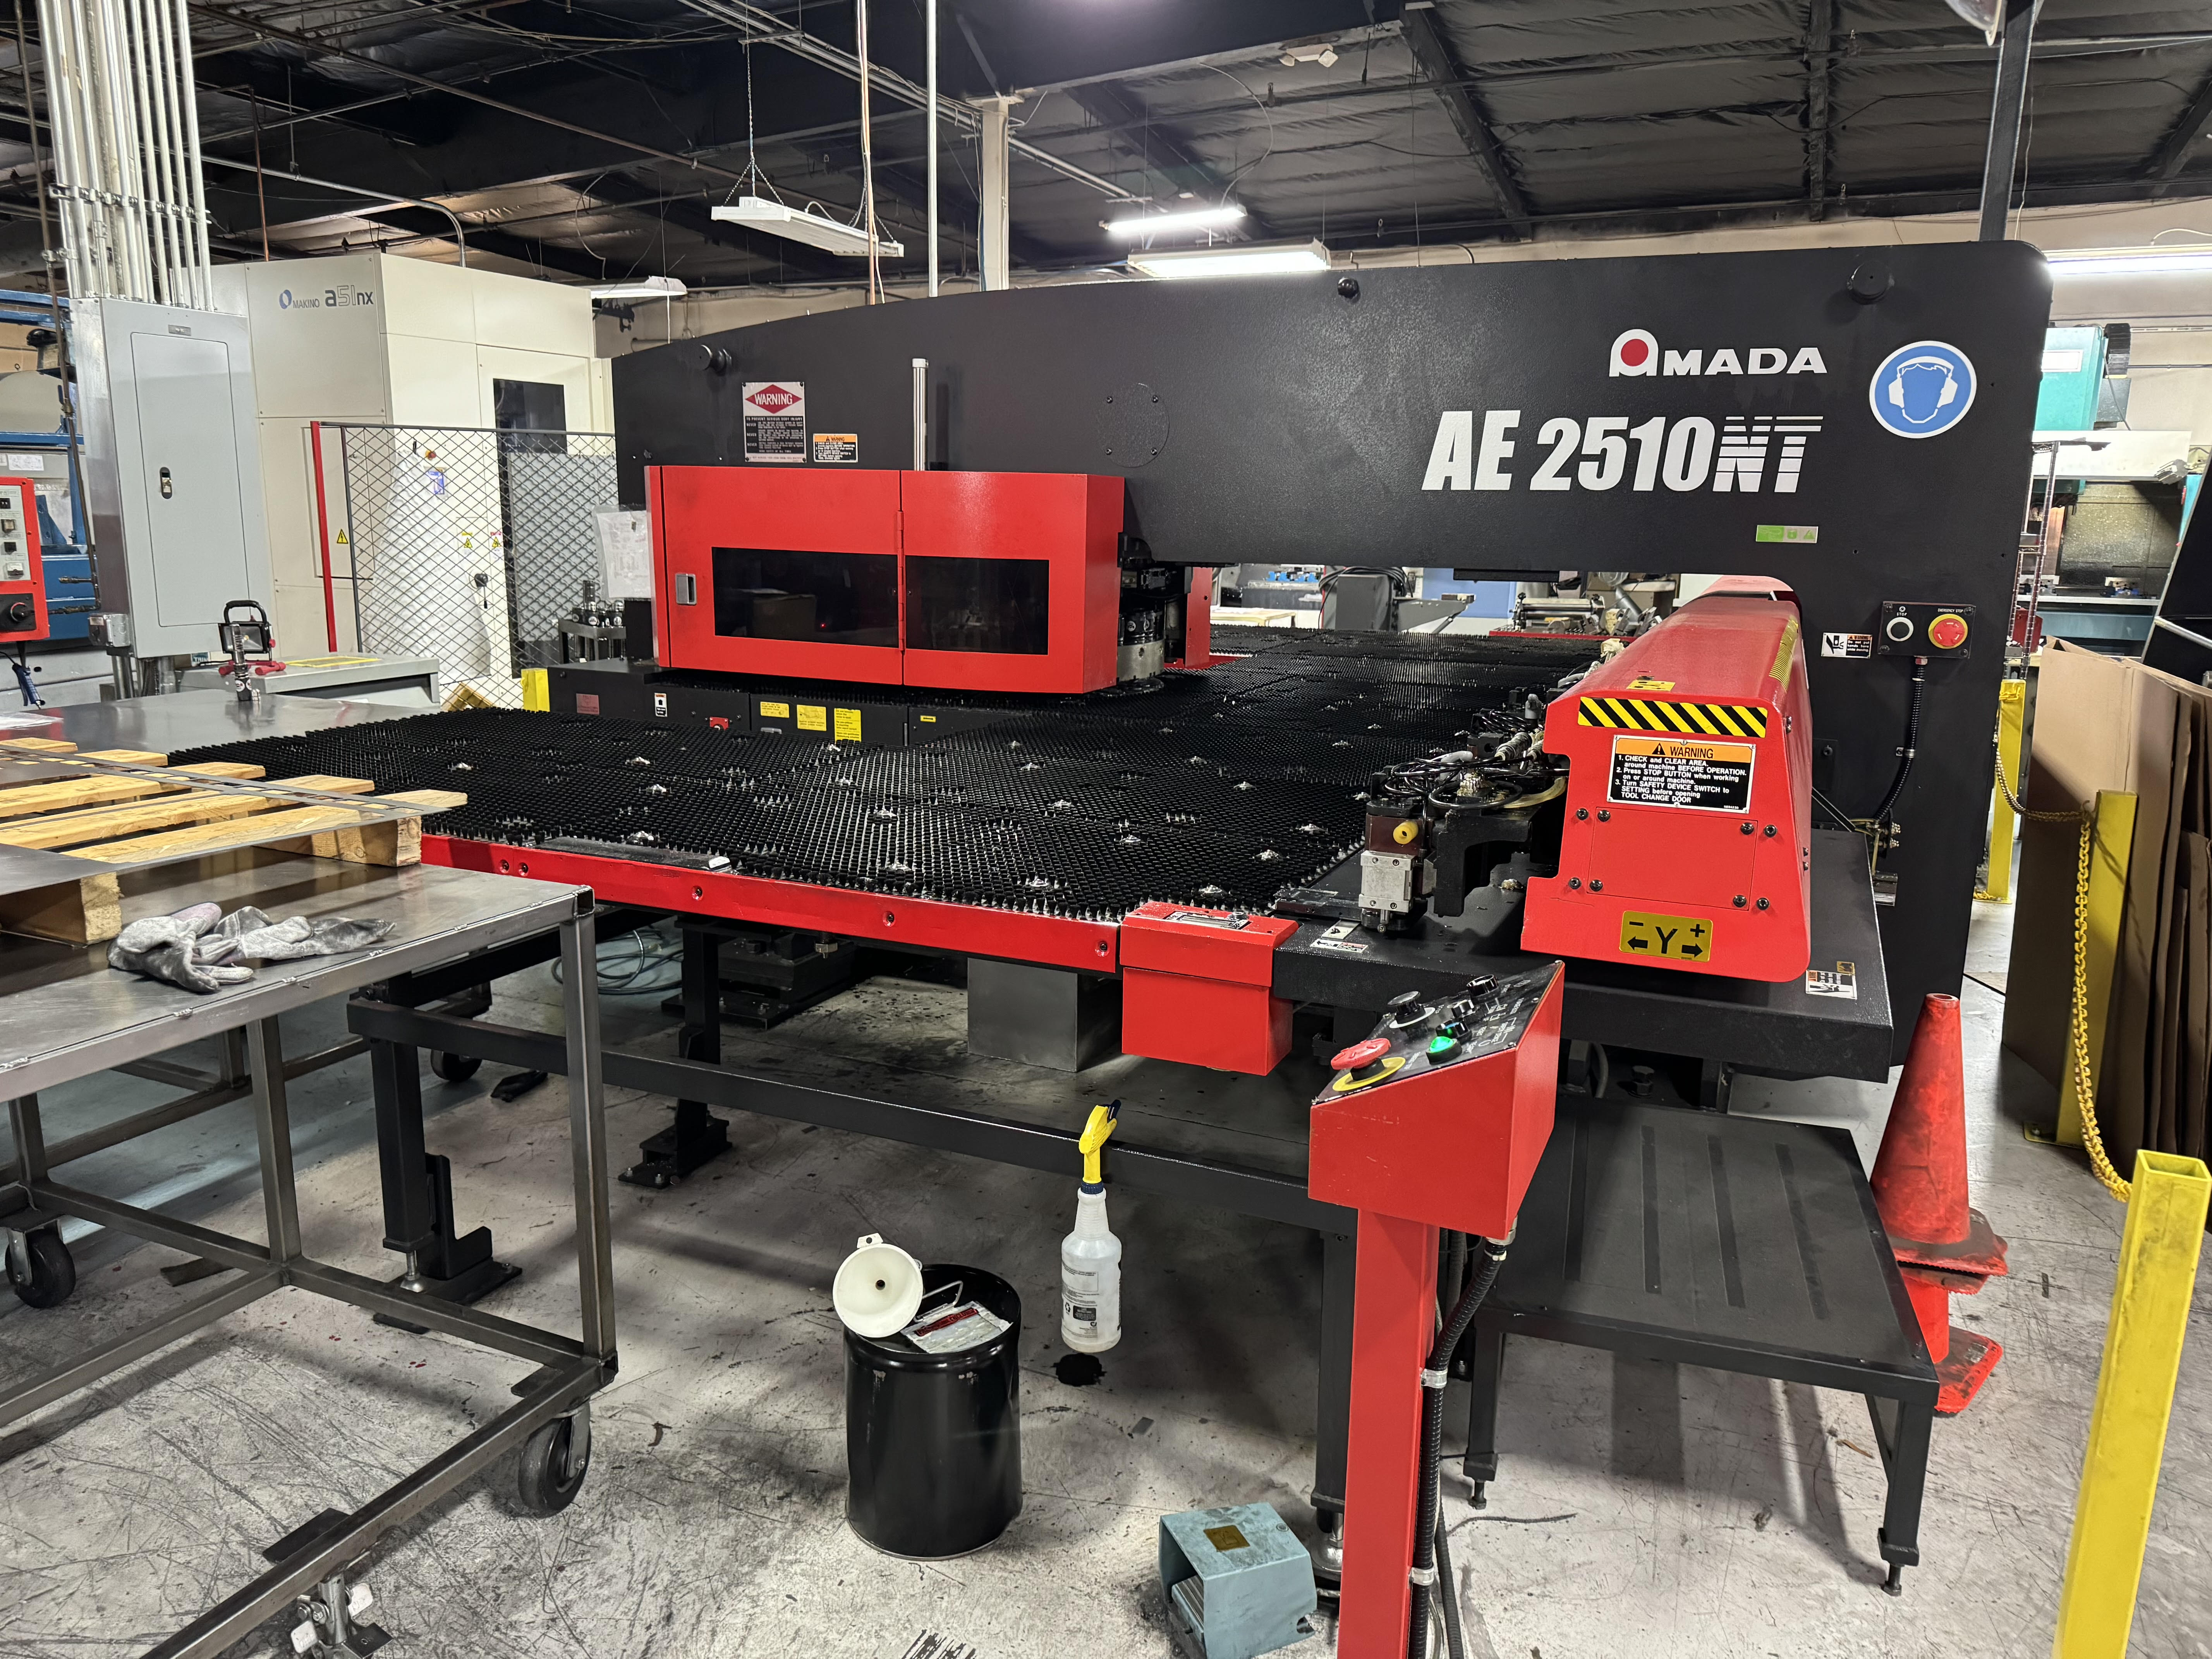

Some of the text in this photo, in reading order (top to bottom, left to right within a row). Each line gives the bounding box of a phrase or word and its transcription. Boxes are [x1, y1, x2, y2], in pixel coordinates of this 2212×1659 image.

[293, 299, 319, 308] MAKINO
[1609, 329, 1827, 377] AMADA
[754, 393, 793, 405] WARNING
[1421, 410, 1520, 490] AE
[1670, 746, 1714, 759] WARNING
[1707, 767, 1747, 776] OPERATION.
[1656, 926, 1678, 954] Y
